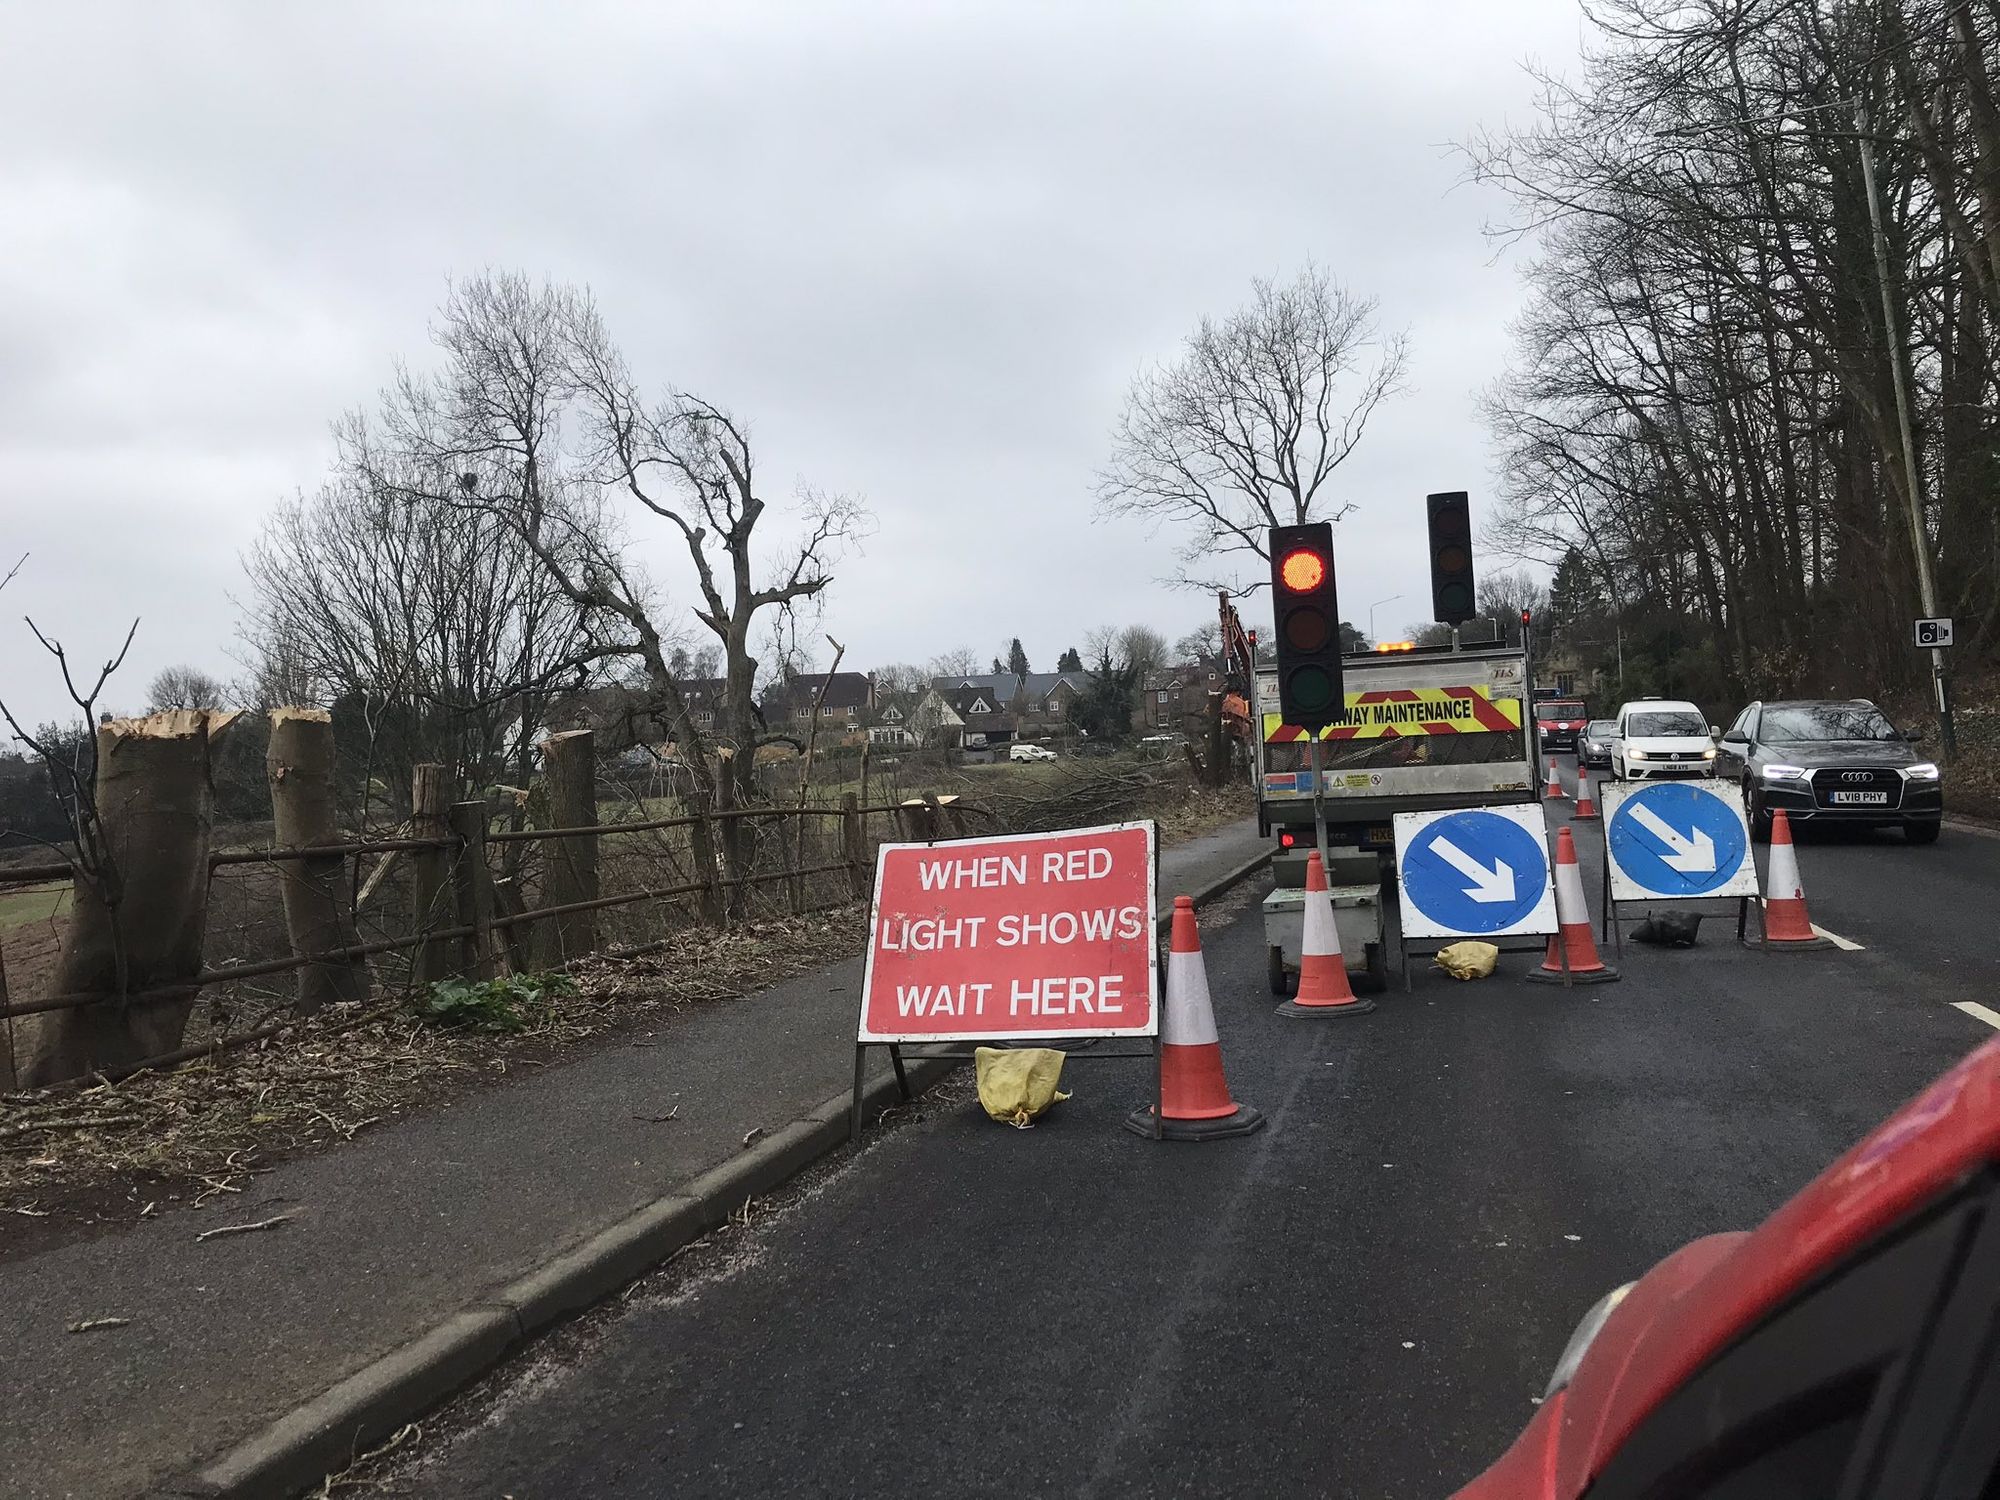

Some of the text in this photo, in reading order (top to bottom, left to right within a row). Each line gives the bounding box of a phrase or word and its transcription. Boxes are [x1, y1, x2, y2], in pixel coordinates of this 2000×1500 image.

[1494, 669, 1515, 678] TLS
[1266, 684, 1280, 693] TL
[1374, 699, 1471, 724] MAINTENANCE
[1838, 792, 1883, 801] LV18 PHY
[1371, 829, 1393, 841] HX6
[919, 848, 1113, 891] WHEN RED
[881, 907, 1142, 950] LIGHT SHOWS
[896, 975, 1124, 1017] WAIT HERE
